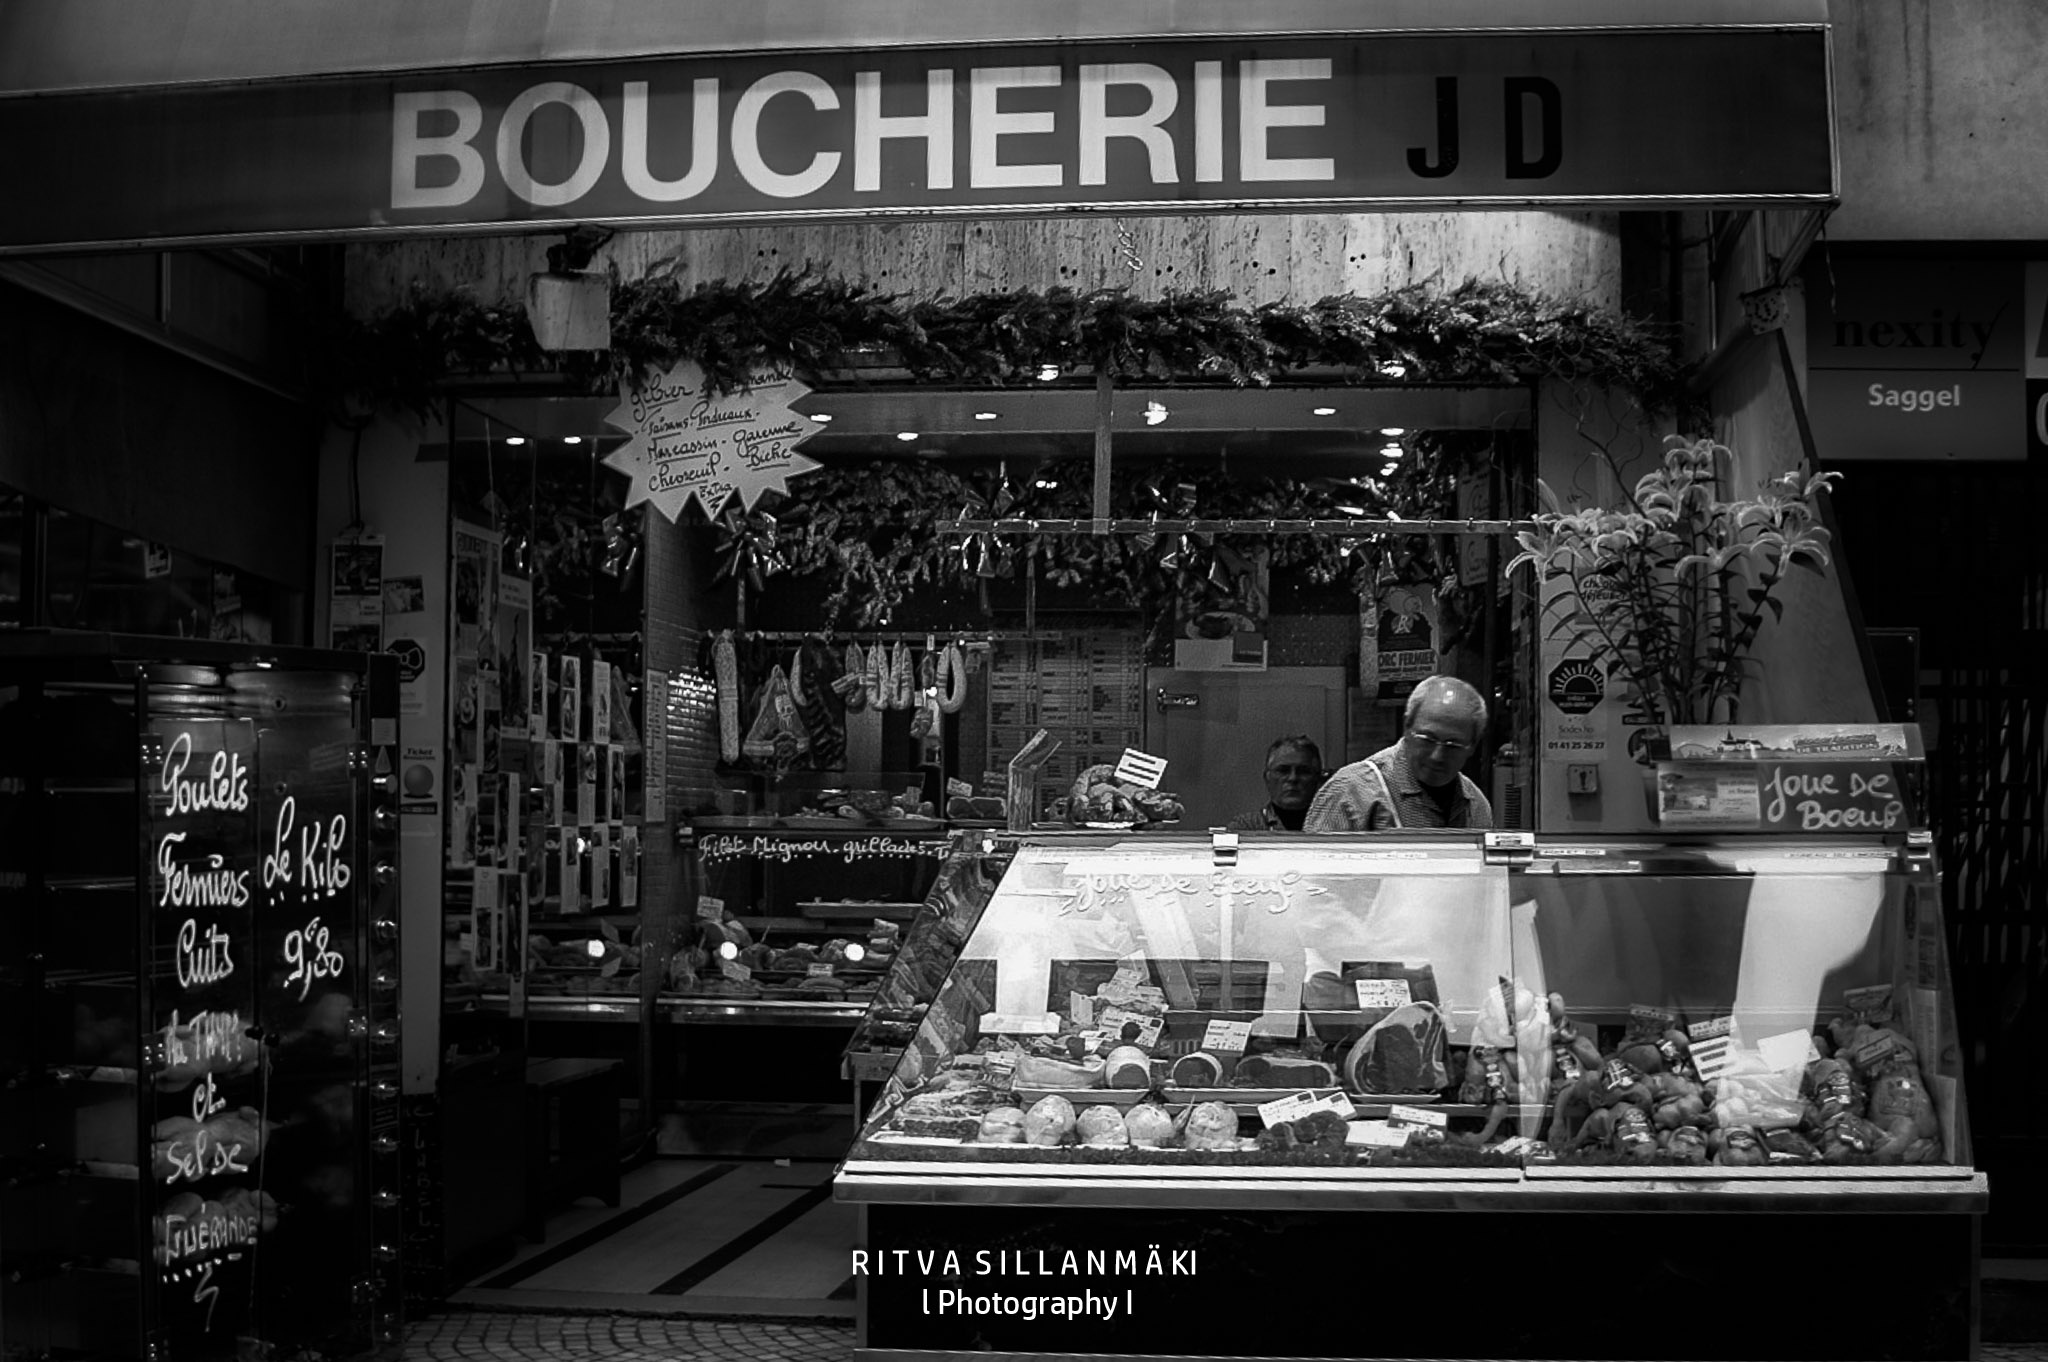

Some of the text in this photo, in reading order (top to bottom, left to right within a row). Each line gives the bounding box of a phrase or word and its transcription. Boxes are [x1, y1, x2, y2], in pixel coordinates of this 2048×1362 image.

[390, 57, 1562, 209] BOUCHERIE J D
[1833, 301, 2009, 370] nexity
[1868, 383, 1960, 411] Saggel
[162, 732, 249, 817] Poulets
[157, 831, 250, 908] Fermiers
[263, 796, 351, 890] Le Kilo
[176, 918, 235, 989] Cuits
[192, 1071, 227, 1123] et
[166, 1130, 206, 1184] Sel
